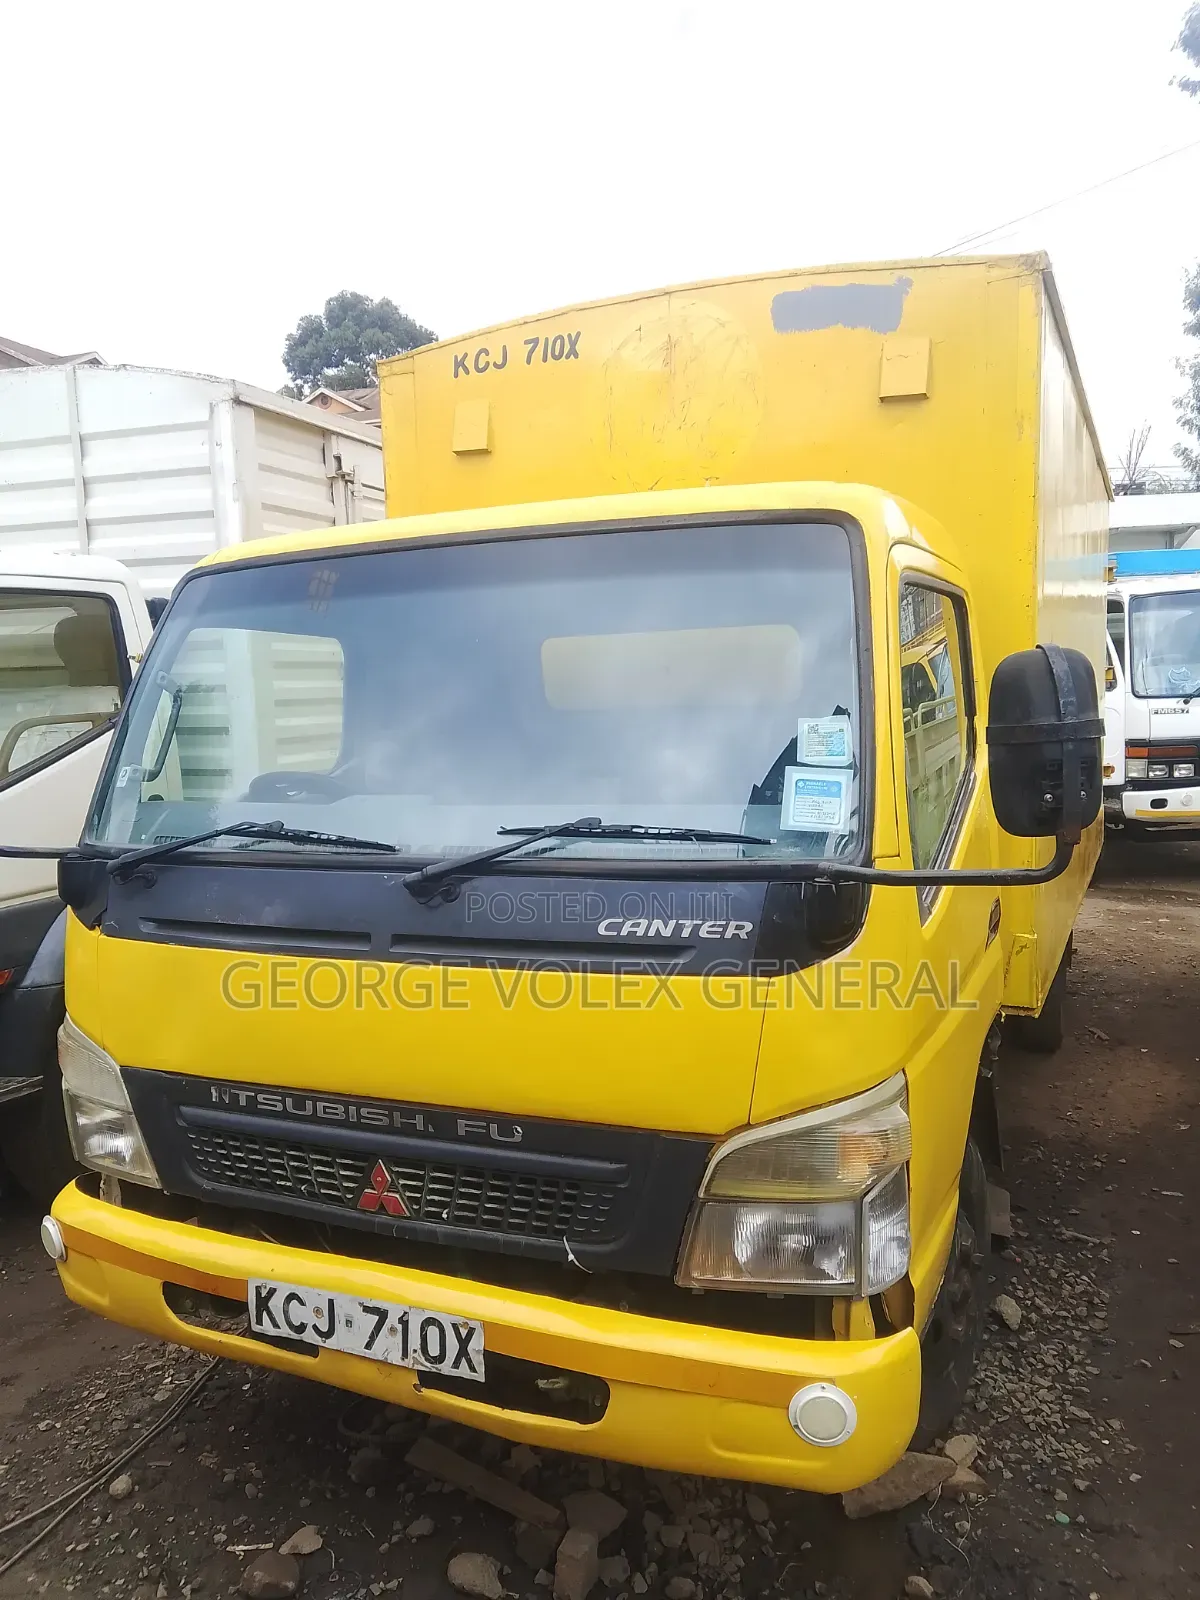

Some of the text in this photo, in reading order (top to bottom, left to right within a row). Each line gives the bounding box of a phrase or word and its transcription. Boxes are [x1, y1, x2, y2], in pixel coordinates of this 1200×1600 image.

[453, 331, 582, 379] KCJ 710X
[597, 918, 754, 940] CANTER
[255, 1285, 479, 1374] KCJ 710X
